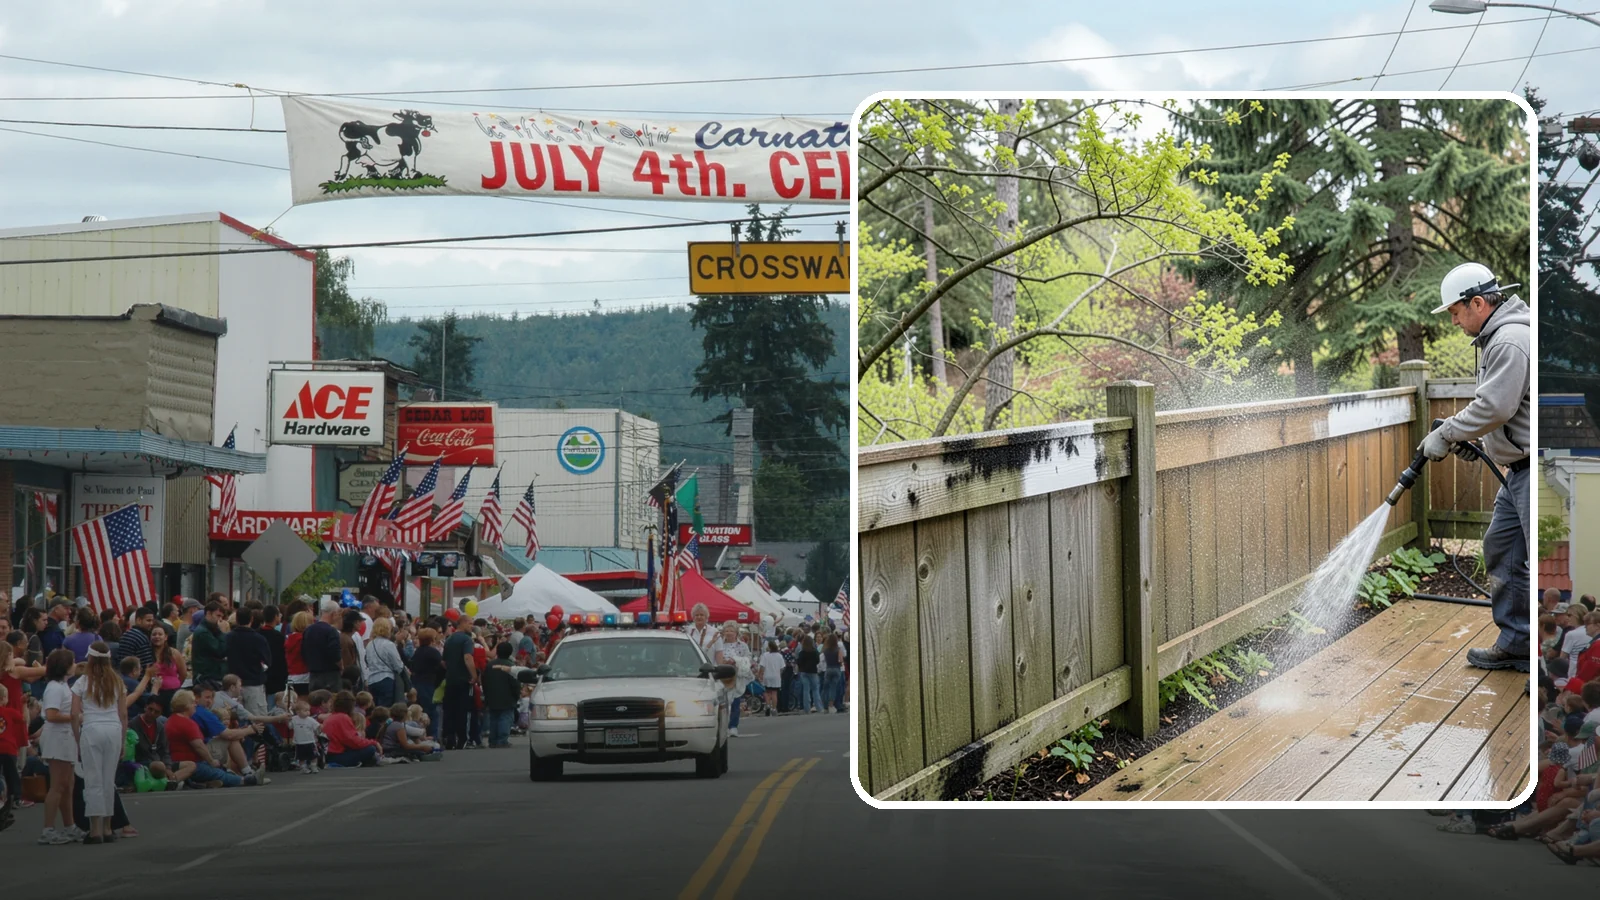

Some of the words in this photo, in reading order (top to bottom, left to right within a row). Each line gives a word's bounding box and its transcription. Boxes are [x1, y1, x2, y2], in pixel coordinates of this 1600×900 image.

[481, 140, 605, 193] JULY
[632, 150, 747, 198] 4th.
[696, 254, 850, 280] CROSSWA
[283, 379, 374, 420] ACE
[405, 409, 452, 422] CEDAR
[461, 409, 485, 421] LOG
[283, 421, 371, 437] Hardware
[416, 428, 477, 447] Coca-Cola
[353, 467, 386, 482] Simpl
[95, 485, 124, 495] Vincent
[126, 486, 136, 495] de
[138, 486, 155, 495] Paul
[688, 526, 741, 535] CRNATION
[699, 535, 731, 543] GLASS
